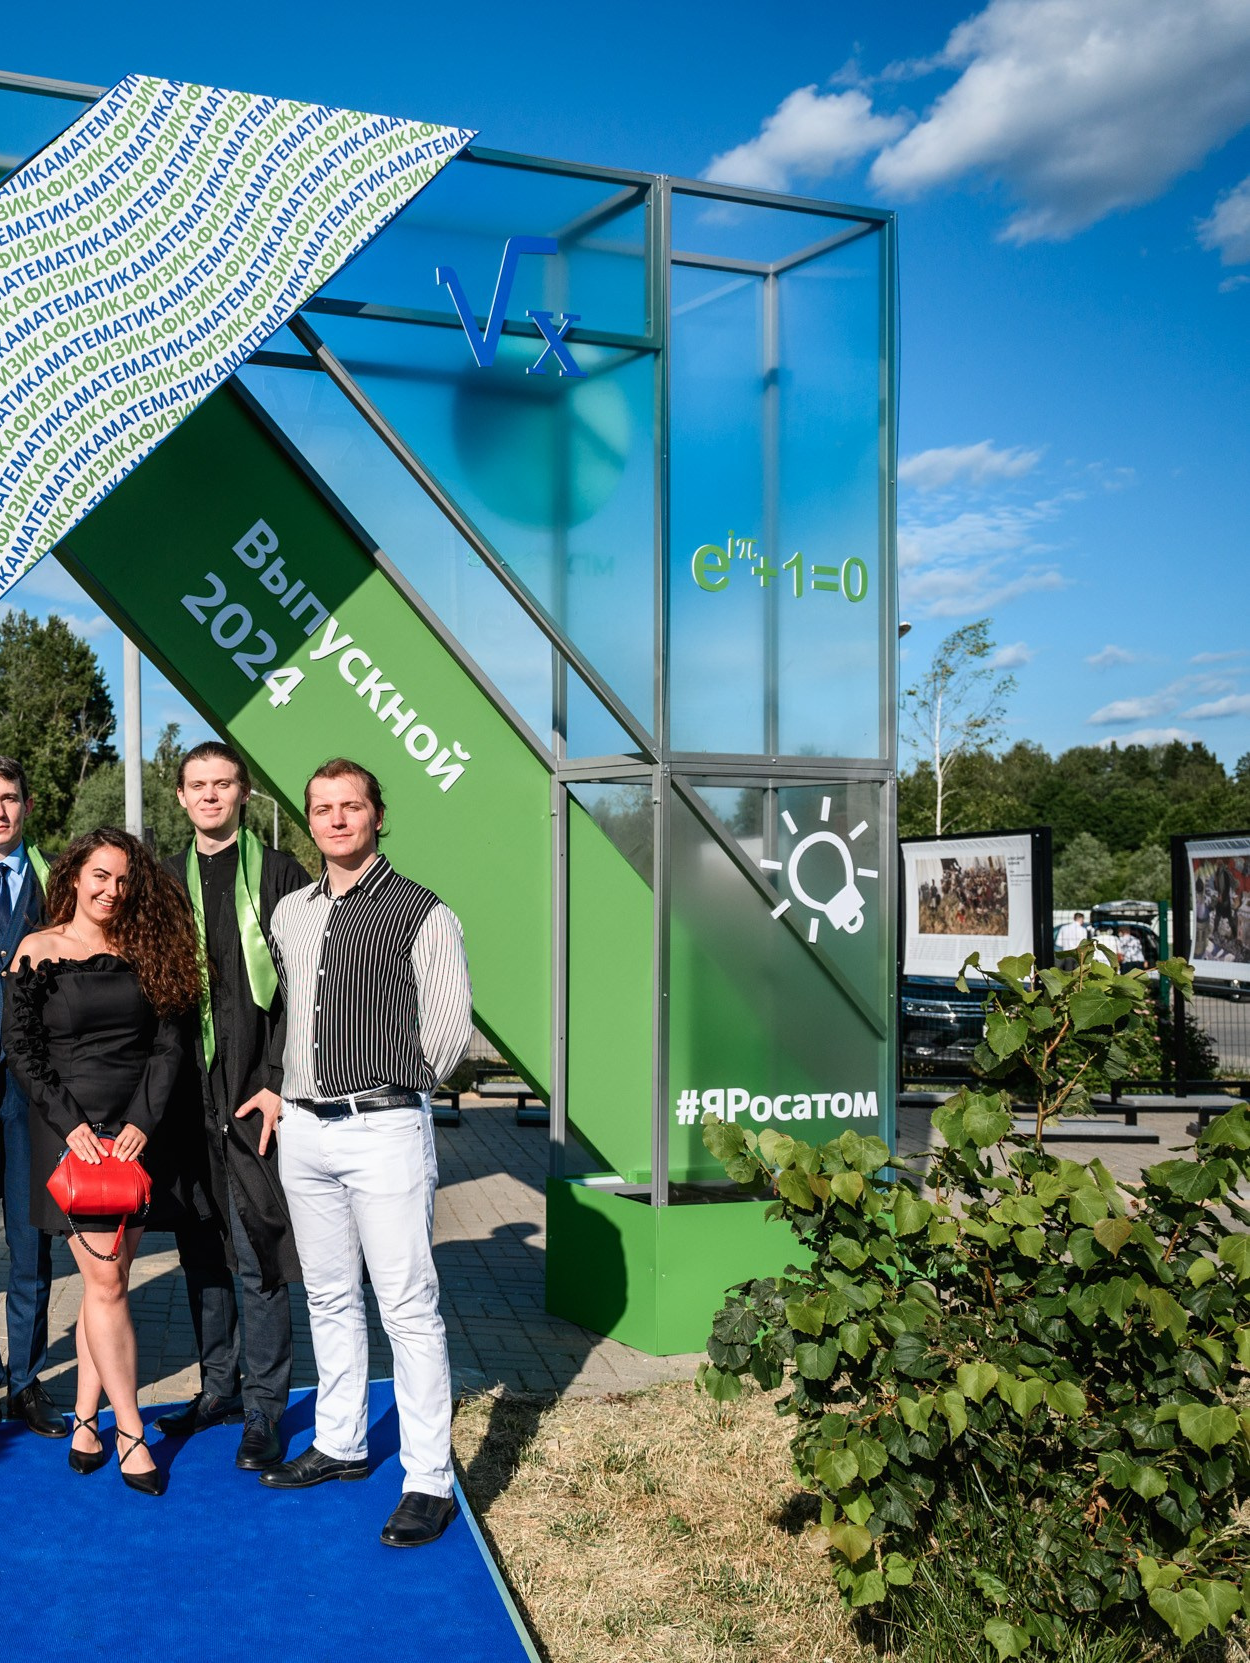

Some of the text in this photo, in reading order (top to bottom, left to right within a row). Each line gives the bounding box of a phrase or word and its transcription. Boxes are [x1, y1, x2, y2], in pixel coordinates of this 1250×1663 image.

[180, 572, 305, 708] 2024
[232, 518, 471, 793] Выпускной
[675, 1087, 879, 1125] #ЯРосатом
